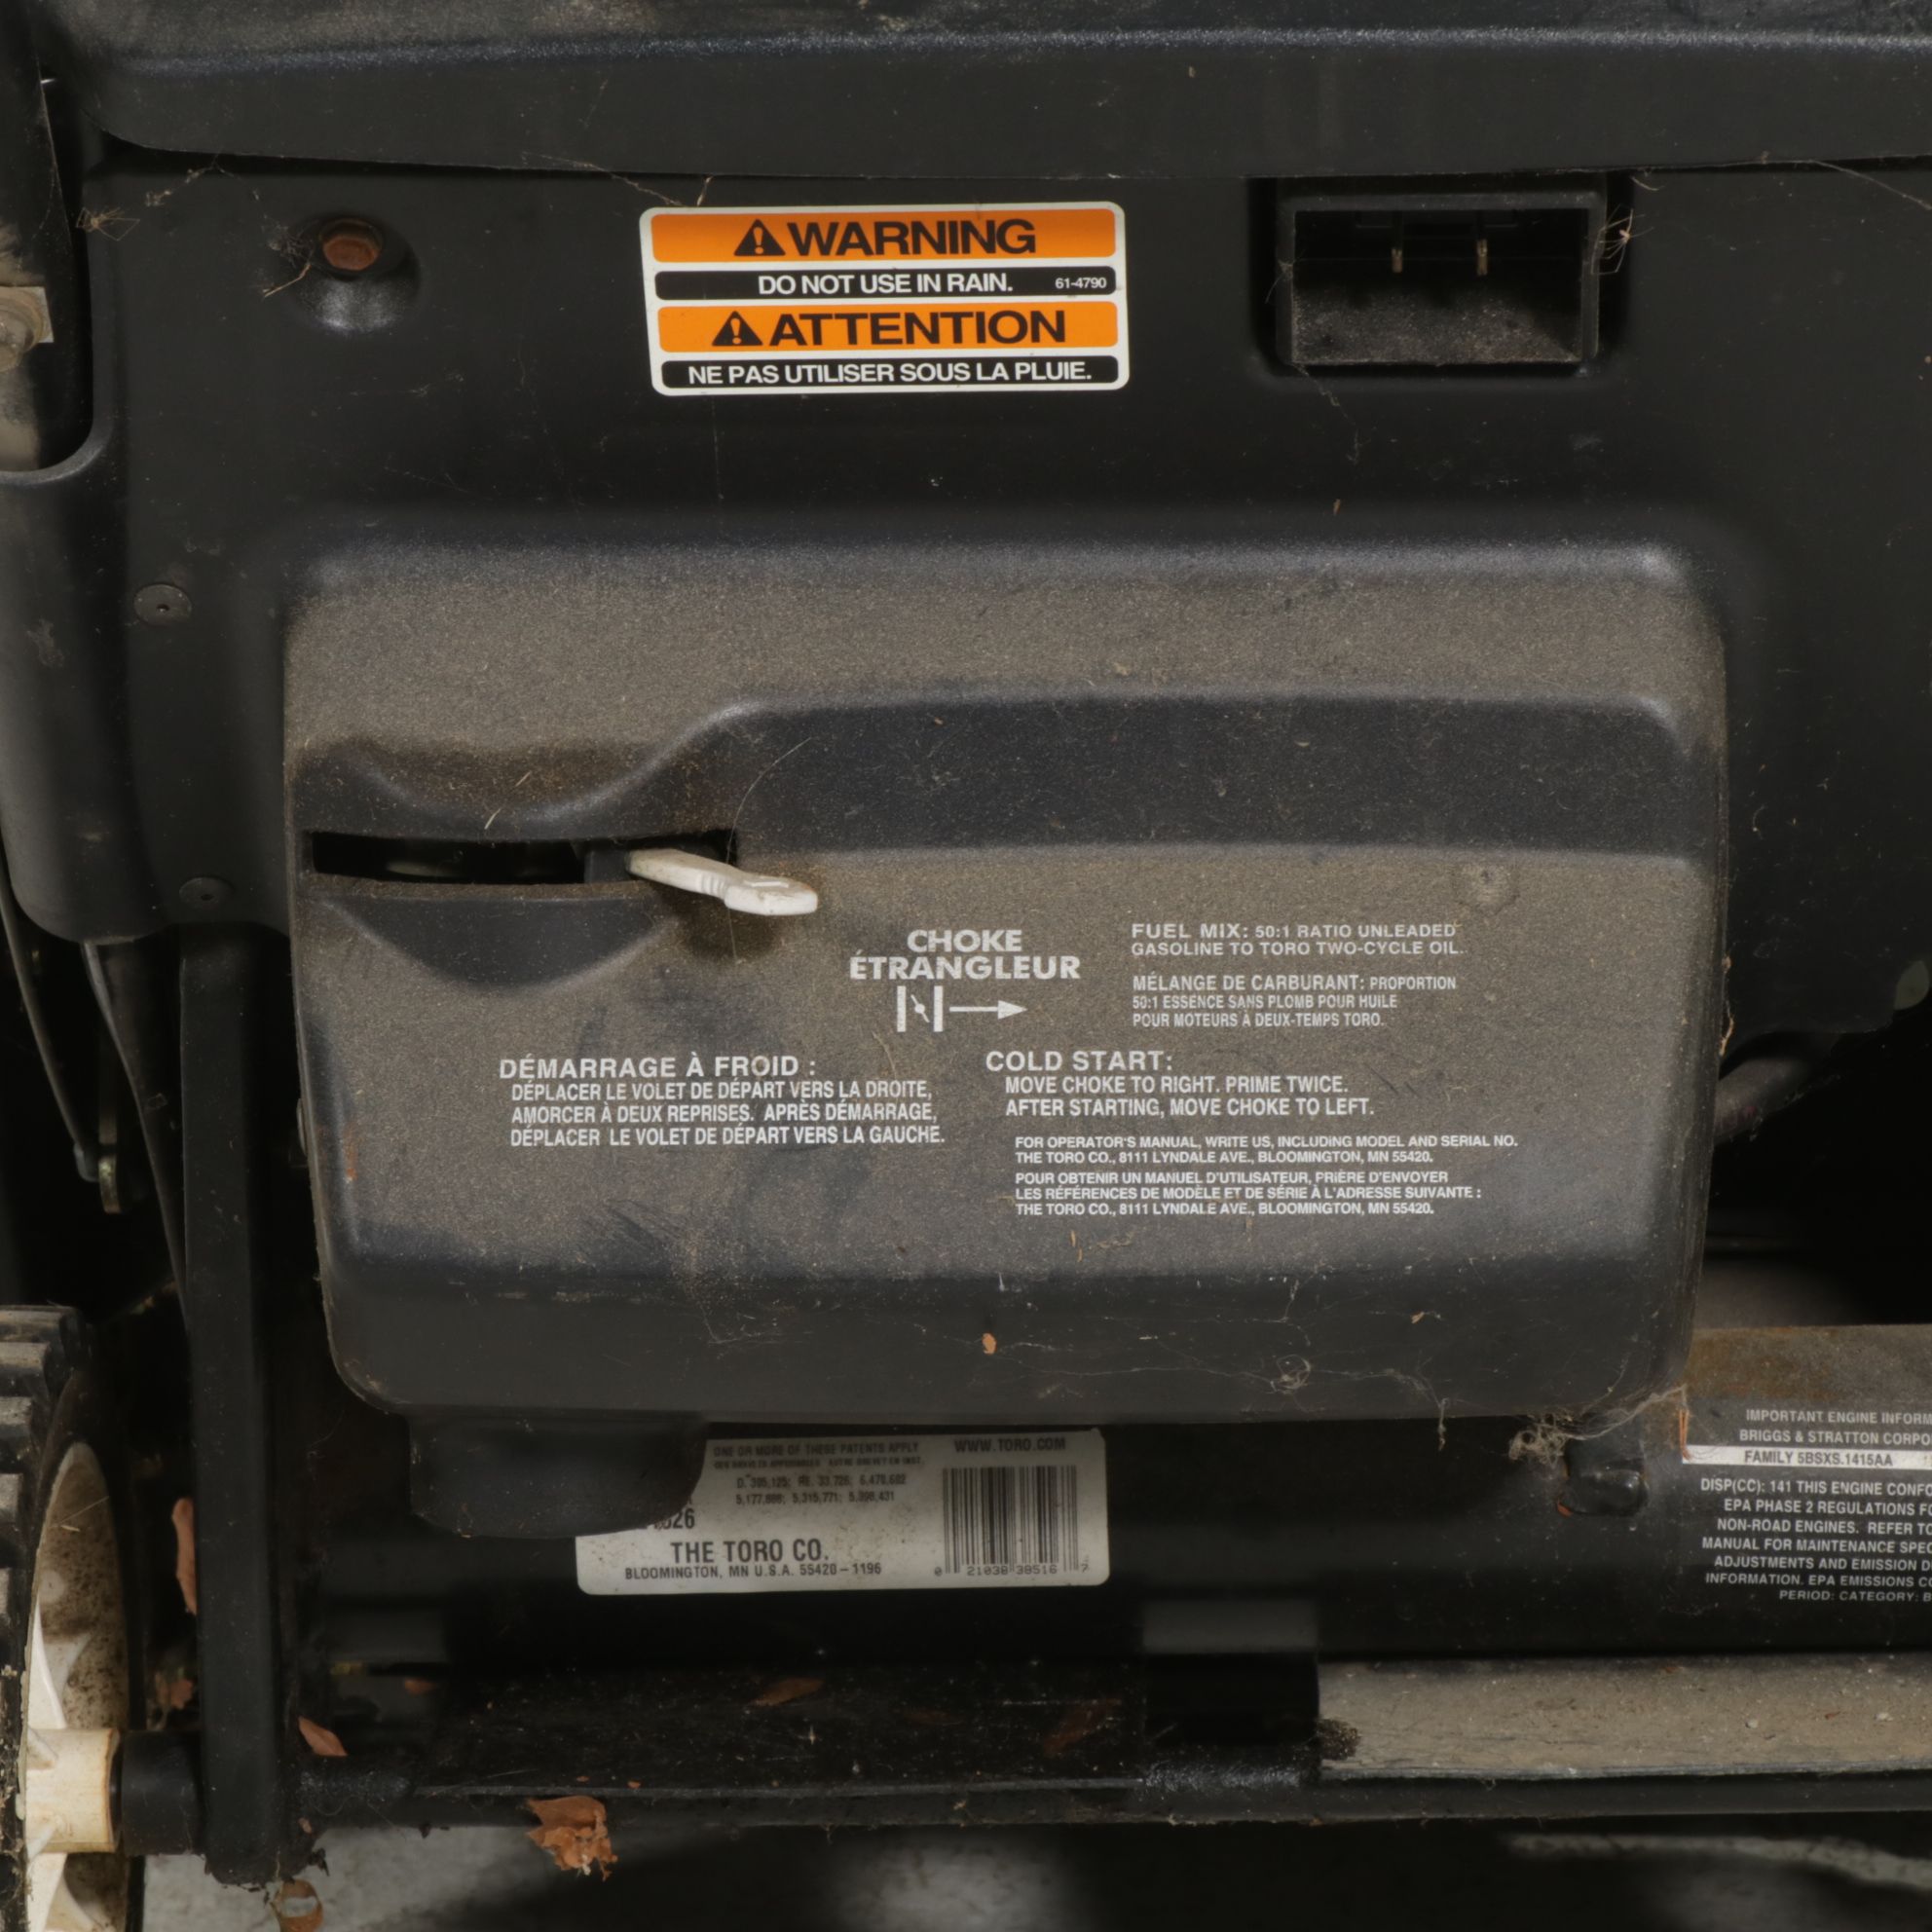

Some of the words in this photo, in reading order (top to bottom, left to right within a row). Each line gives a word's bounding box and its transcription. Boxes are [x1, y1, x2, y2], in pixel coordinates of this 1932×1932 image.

[786, 218, 1036, 255] WARNING
[759, 275, 796, 294] DO
[801, 275, 853, 294] NOT
[860, 274, 910, 293] USE
[916, 274, 942, 292] IN
[947, 272, 1013, 292] RAIN.
[1055, 277, 1107, 289] 61-4790
[768, 310, 1065, 346] ATTENTION
[688, 365, 723, 385] NE
[728, 365, 778, 384] PAS
[784, 363, 894, 383] UTILISER
[899, 362, 971, 382] SOUS
[977, 361, 1010, 381] LA
[1015, 360, 1092, 380] PLUIE.
[1132, 923, 1191, 938] FUEL
[1201, 923, 1248, 938] MIX:
[1255, 925, 1290, 938] 50:1
[1297, 925, 1352, 938] RATIO
[1358, 925, 1456, 938] UNLEADED
[907, 929, 1022, 952] CHOKE
[1132, 942, 1223, 956] GASOLINE
[1231, 942, 1253, 955] TO
[1262, 942, 1310, 955] TORO
[1318, 942, 1423, 954] TWO-CYCLE
[849, 948, 1080, 980] ÉTRANGLEUR
[1133, 972, 1216, 991] MÉLANGE
[1223, 976, 1245, 990] DE
[1251, 975, 1364, 990] CARBURANT:
[1370, 976, 1456, 990] PROPORTION
[1133, 996, 1158, 1009] 50:1
[1164, 995, 1223, 1009] ESSENCE
[1229, 995, 1263, 1009] SANS
[1268, 995, 1314, 1009] PLOMB
[1319, 994, 1355, 1008] POUR
[1359, 994, 1397, 1008] HUILE
[1133, 1013, 1170, 1027] POUR
[1173, 1013, 1238, 1027] MOTEURS
[1242, 1009, 1251, 1027] À
[1255, 1013, 1339, 1026] DEUX-TEMPS
[1344, 1013, 1384, 1026] TORO.
[500, 1054, 676, 1079] DÉMARRAGE
[686, 1052, 704, 1077] À
[985, 1051, 1062, 1071] COLD
[1073, 1051, 1173, 1070] START:
[512, 1080, 601, 1102] DÉPLACER
[607, 1083, 627, 1100] LE
[632, 1082, 687, 1100] VOLET
[692, 1082, 712, 1099] DE
[719, 1077, 785, 1099] DÉPART
[790, 1080, 835, 1099] VERS
[839, 1080, 861, 1098] LA
[866, 1080, 932, 1100] DROITE,
[1006, 1076, 1056, 1094] MOVE
[1062, 1076, 1126, 1094] CHOKE
[1132, 1076, 1155, 1094] TO
[1161, 1076, 1220, 1094] RIGHT.
[1226, 1076, 1281, 1093] PRIME
[1286, 1075, 1349, 1093] TWICE.
[512, 1105, 595, 1124] AMORCER
[601, 1100, 613, 1123] À
[616, 1104, 662, 1123] DEUX
[667, 1103, 754, 1123] REPRISES.
[764, 1099, 820, 1122] APRÈS
[826, 1098, 938, 1124] DÉMARRAGE,
[1006, 1099, 1064, 1116] AFTER
[1070, 1098, 1165, 1119] STARTING,
[1170, 1098, 1221, 1115] MOVE
[1227, 1097, 1290, 1115] CHOKE
[1296, 1097, 1320, 1115] TO
[1325, 1097, 1374, 1115] LEFT.
[511, 1126, 600, 1147] DÉPLACER
[610, 1128, 631, 1146] LE
[636, 1128, 689, 1146] VOLET
[695, 1128, 717, 1145] DE
[724, 1123, 790, 1145] DÉPART
[795, 1126, 838, 1145] VERS
[843, 1126, 865, 1144] LA
[870, 1125, 945, 1144] GAUCHE.
[1016, 1137, 1044, 1148] FOR
[1047, 1136, 1136, 1148] OPERATOR'S
[1139, 1136, 1201, 1149] MANUAL,
[1206, 1136, 1248, 1147] WRITE
[1252, 1136, 1275, 1149] US,
[1278, 1136, 1353, 1147] INCLUDING
[1356, 1135, 1404, 1147] MODEL
[1408, 1135, 1437, 1147] AND
[1441, 1135, 1491, 1147] SERIAL
[1494, 1135, 1518, 1146] NO.
[1016, 1152, 1042, 1163] THE
[1046, 1152, 1085, 1163] TORO
[1088, 1152, 1116, 1165] CO.,
[1119, 1152, 1148, 1163] 8111
[1153, 1152, 1215, 1163] LYNDALE
[1219, 1152, 1254, 1165] AVE.,
[1258, 1151, 1364, 1164] BLOOMINGTON,
[1368, 1151, 1389, 1162] MN
[1393, 1151, 1433, 1162] 55420.
[1016, 1172, 1055, 1184] POUR
[1058, 1172, 1118, 1184] OBTENIR
[1122, 1172, 1141, 1184] UN
[1145, 1172, 1203, 1184] MANUEL
[1207, 1172, 1312, 1185] D'UTILISATEUR,
[1316, 1169, 1365, 1183] PRIÈRE
[1369, 1171, 1448, 1183] D'ENVOYER
[1016, 1188, 1042, 1200] LES
[1045, 1185, 1137, 1200] RÉFÉRENCES
[1140, 1188, 1159, 1200] DE
[1163, 1185, 1220, 1200] MODÈLE
[1224, 1188, 1241, 1199] ET
[1245, 1187, 1263, 1199] DE
[1267, 1184, 1307, 1199] SÉRIE
[1311, 1184, 1320, 1199] À
[1324, 1187, 1401, 1199] L'ADRESSE
[1747, 1410, 1823, 1423] IMPORTANT
[1828, 1412, 1877, 1424] ENGINE
[953, 1438, 1066, 1452] WWW.TORO.COM
[1740, 1430, 1791, 1442] BRIGGS
[1795, 1430, 1804, 1442] &
[1808, 1431, 1878, 1444] STRATTON
[1744, 1450, 1794, 1465] FAMILY
[1798, 1452, 1893, 1466] 5BSXS.1415AA
[1701, 1478, 1765, 1495] DISP(CC):
[1770, 1481, 1791, 1493] 141
[1797, 1481, 1827, 1494] THIS
[1832, 1481, 1882, 1495] ENGINE
[1725, 1500, 1751, 1511] EPA
[1756, 1500, 1802, 1513] PHASE
[1805, 1501, 1813, 1513] 2
[1817, 1501, 1914, 1515] REGULATIONS
[1718, 1519, 1791, 1532] NON-ROAD
[1795, 1520, 1859, 1534] ENGINES.
[1868, 1522, 1913, 1535] REFER
[671, 1542, 717, 1563] THE
[724, 1541, 783, 1561] TORO
[793, 1538, 829, 1560] CO.
[1702, 1538, 1760, 1550] MANUAL
[1765, 1539, 1792, 1550] FOR
[1797, 1540, 1894, 1553] MAINTENANCE
[967, 1565, 1009, 1577] 21038
[1016, 1564, 1058, 1575] 38516
[1714, 1556, 1814, 1569] ADJUSTMENTS
[1819, 1558, 1847, 1569] AND
[1851, 1559, 1916, 1571] EMISSION
[624, 1566, 724, 1580] BLOOMINGTON,
[728, 1565, 750, 1579] MN
[755, 1564, 794, 1577] U.S.A.
[1706, 1574, 1804, 1584] INFORMATION.
[1808, 1576, 1836, 1585] EPA
[1840, 1576, 1914, 1587] EMISSIONS
[1779, 1590, 1835, 1600] PERIOD:
[1839, 1591, 1918, 1602] CATEGORY:
